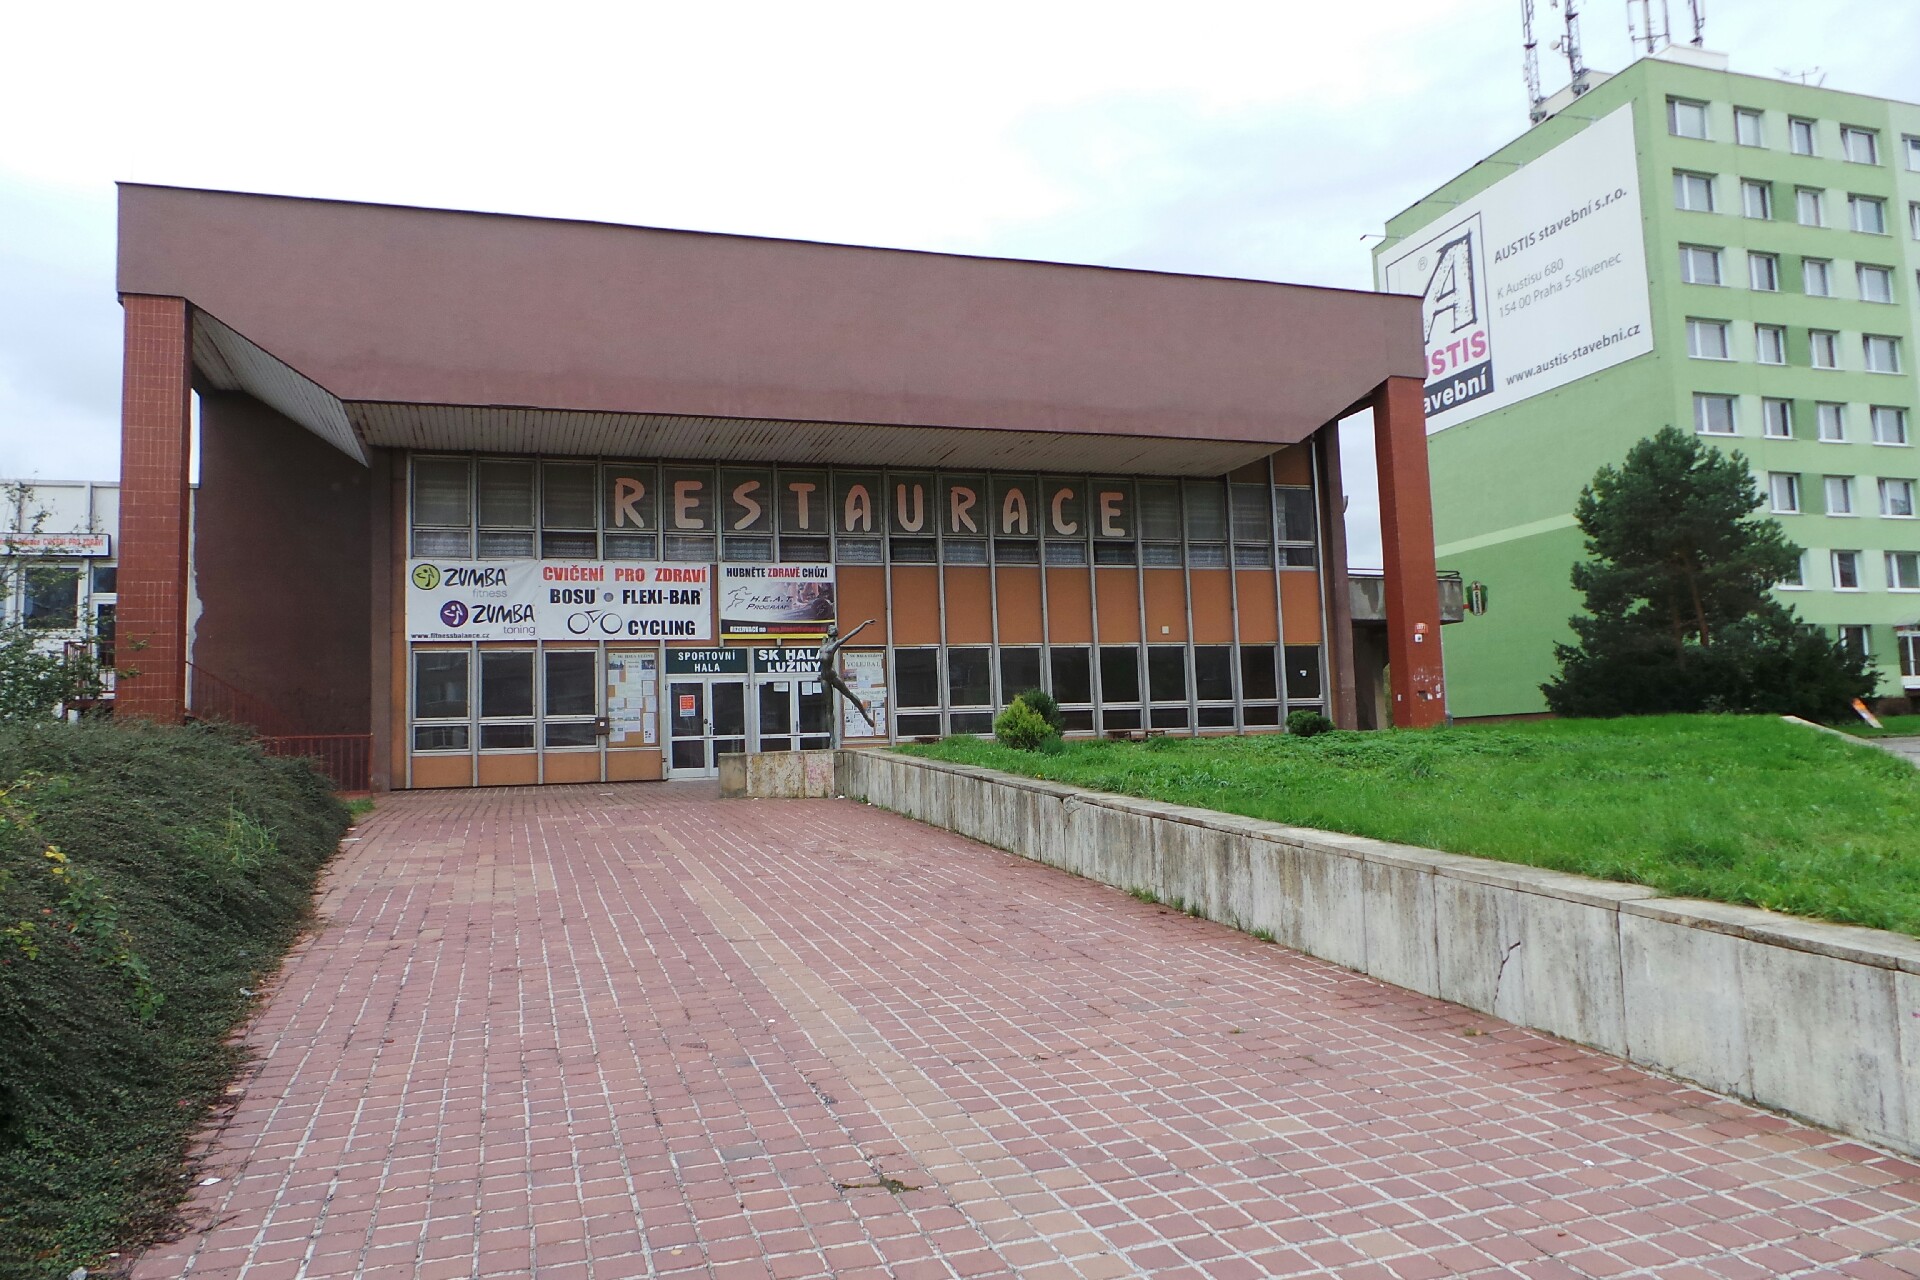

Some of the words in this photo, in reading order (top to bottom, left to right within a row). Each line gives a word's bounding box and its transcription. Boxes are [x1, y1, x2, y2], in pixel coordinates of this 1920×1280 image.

[1494, 231, 1536, 264] AUSTIS
[1538, 200, 1592, 241] stavební
[1594, 188, 1627, 211] s.r.o.
[1497, 288, 1504, 300] K
[1506, 271, 1542, 297] Austisu
[1544, 257, 1564, 277] 680
[1499, 301, 1517, 318] 154
[1518, 294, 1531, 309] 00
[1533, 279, 1563, 302] Praha
[1565, 252, 1622, 288] 5-Slivenec
[1425, 330, 1487, 377] STIS
[1506, 324, 1641, 386] www.austis-stavebni.cz
[1424, 366, 1487, 414] avební
[615, 477, 1126, 537] RESTAURACE
[443, 567, 507, 588] ZUMBA
[543, 564, 605, 582] CVIČENÍ
[615, 567, 646, 582] PRO
[654, 567, 707, 583] ZDRAVÍ
[726, 566, 766, 578] HUBNĚTE
[767, 566, 801, 578] ZDRAVĚ
[802, 566, 828, 578] CHŮZÍ
[472, 589, 508, 598] fitness
[550, 588, 596, 604] BOSU
[622, 589, 701, 605] FLEXI-BAR
[471, 603, 536, 624] ZUMBA
[503, 625, 536, 636] toning
[627, 619, 696, 636] CYCLING
[678, 649, 736, 661] SPORTOVNÍ
[758, 649, 779, 661] SK
[694, 663, 721, 673] HALA
[767, 659, 821, 673] LUŽINY
